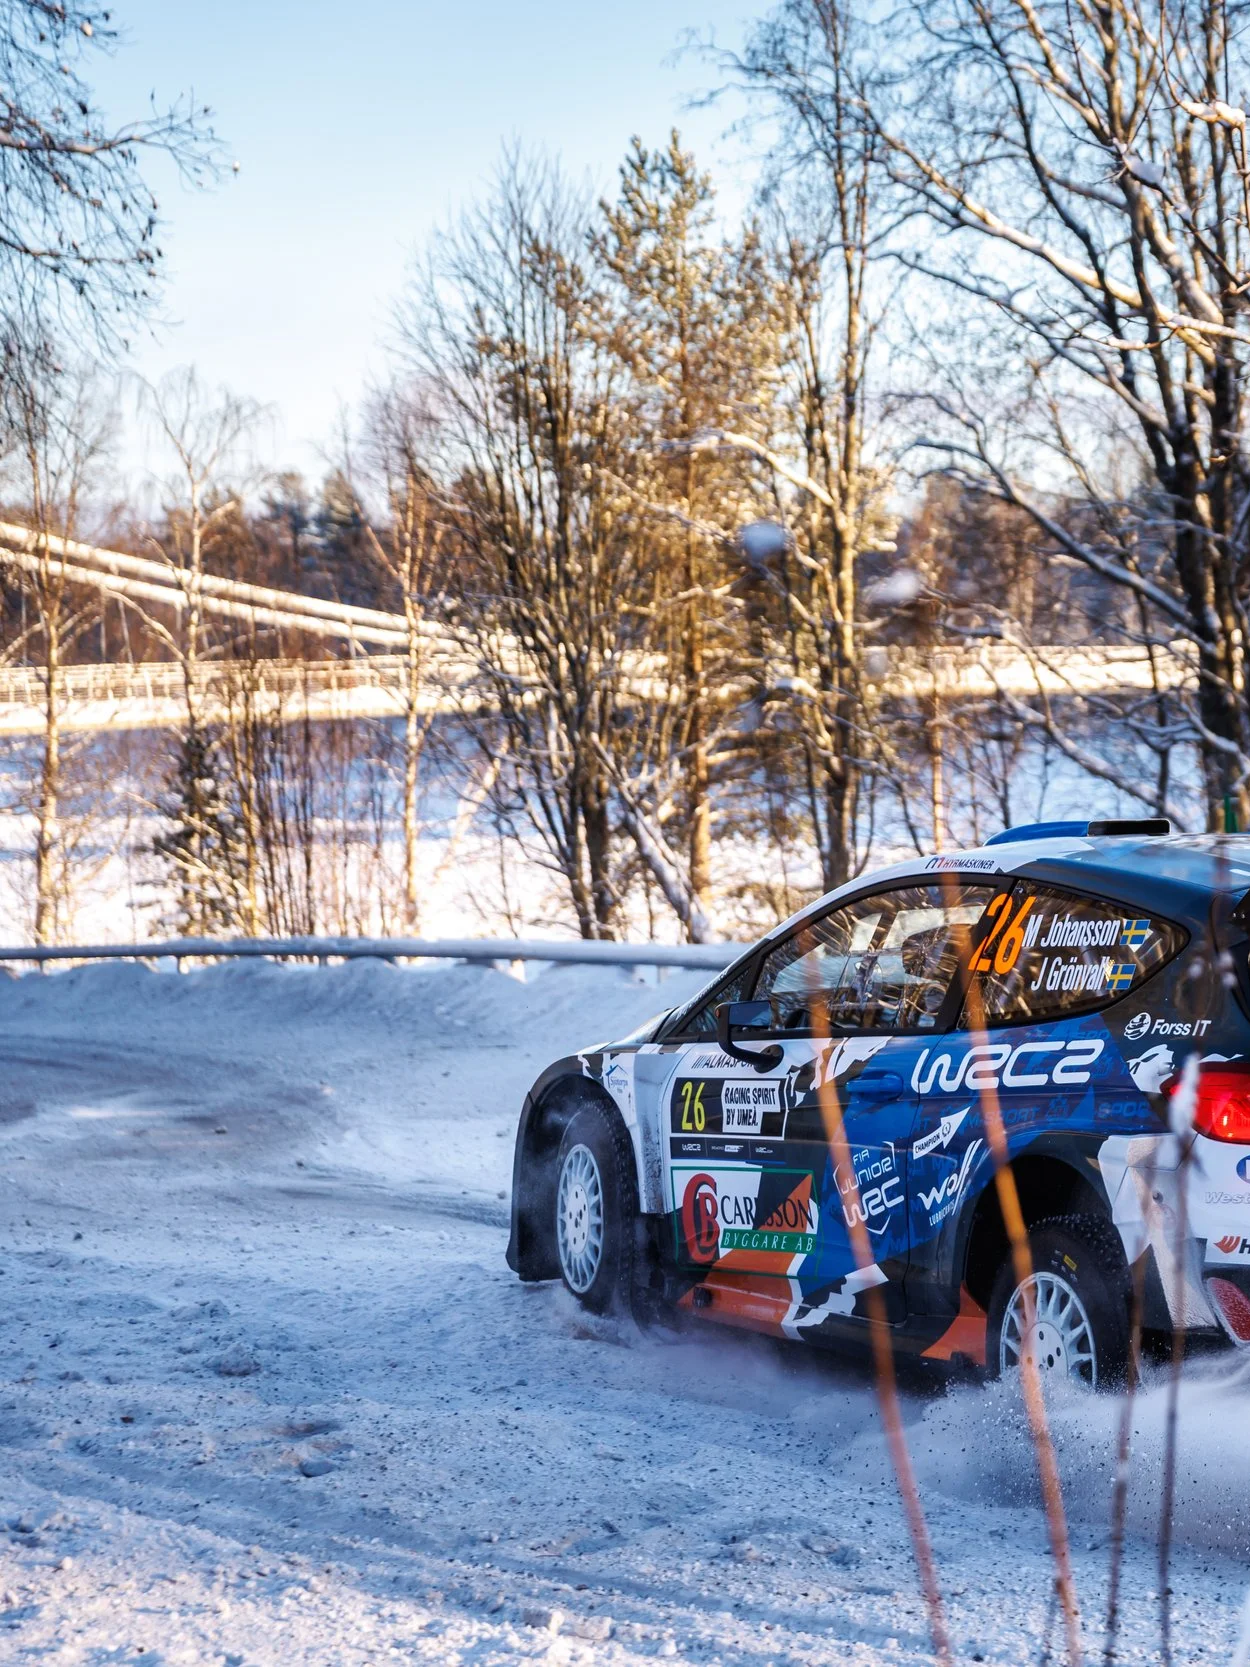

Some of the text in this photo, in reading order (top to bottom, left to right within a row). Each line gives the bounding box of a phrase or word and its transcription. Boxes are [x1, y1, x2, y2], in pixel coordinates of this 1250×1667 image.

[968, 893, 1037, 975] 26
[1021, 913, 1121, 948] M Johansson
[1031, 956, 1049, 991] J
[1151, 1019, 1212, 1037] Forss IT
[910, 1039, 1105, 1094] WRC2
[681, 1081, 706, 1132] 26
[724, 1087, 776, 1105] RACING SPIRIT
[726, 1108, 736, 1126] BY
[852, 1148, 870, 1166] FIA
[840, 1156, 893, 1195] JUNIOR
[842, 1175, 905, 1228] WRC
[723, 1232, 813, 1252] BYGGARE AB
